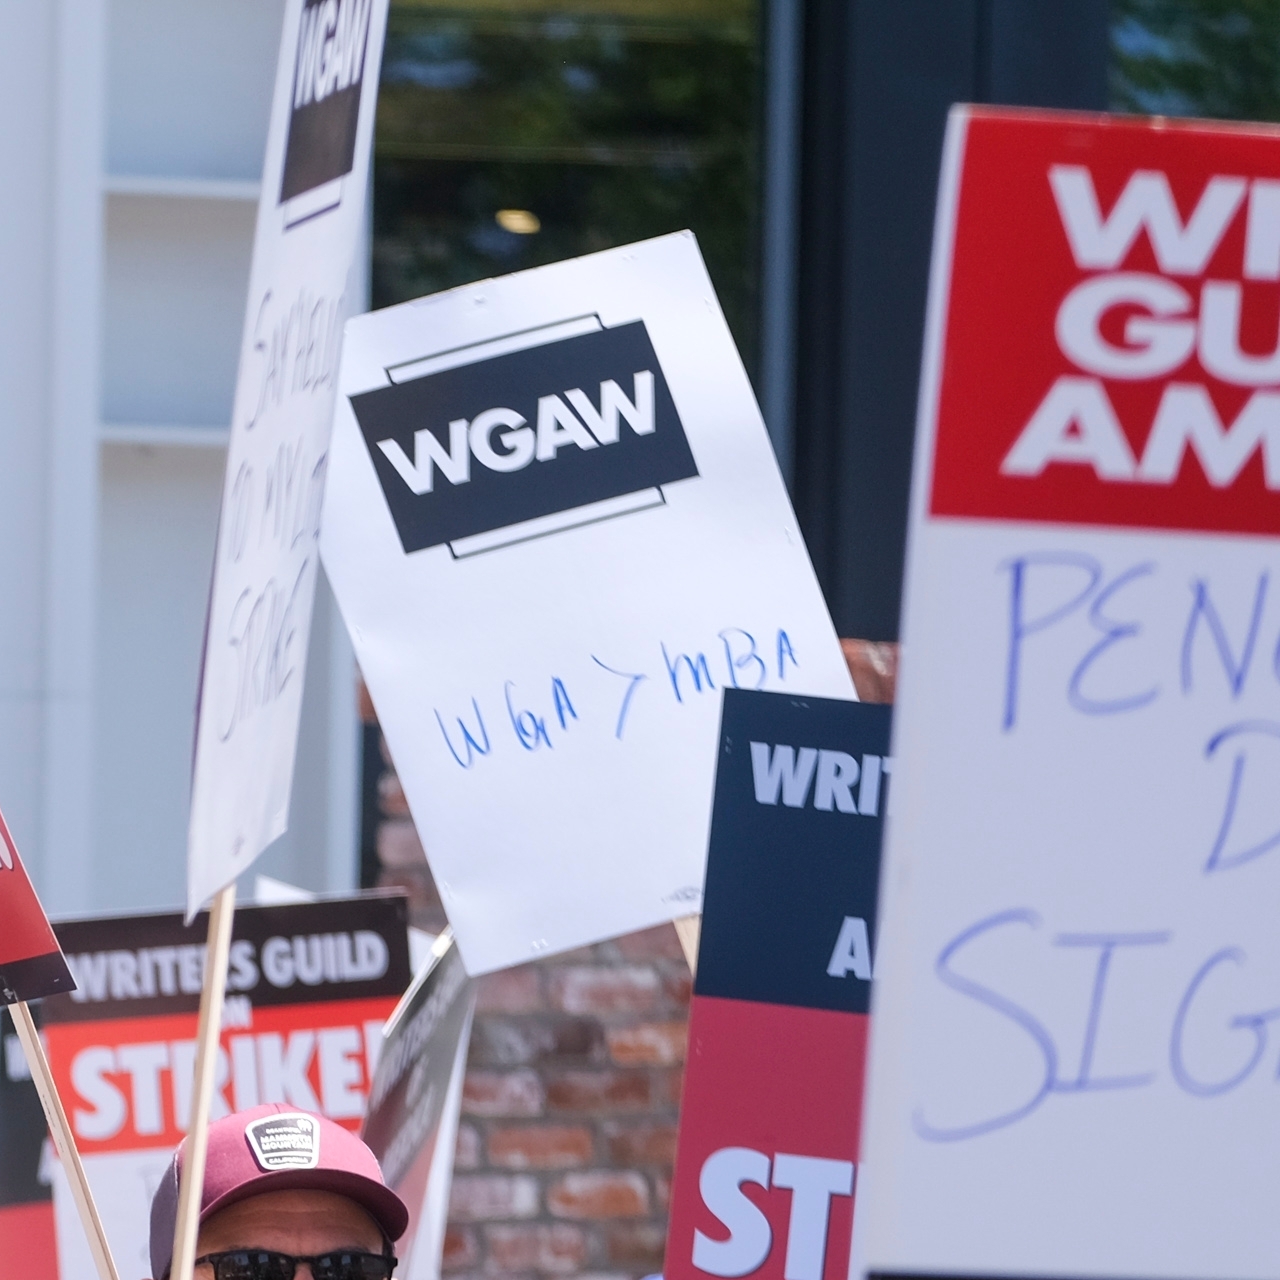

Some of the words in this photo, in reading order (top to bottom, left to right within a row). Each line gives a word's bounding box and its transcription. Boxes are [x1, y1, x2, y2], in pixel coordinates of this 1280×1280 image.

[376, 370, 654, 496] WGAW
[999, 549, 1280, 733] PEN
[66, 937, 260, 1004] WRITES
[260, 929, 390, 989] GUILD
[912, 906, 1280, 1143] SIG
